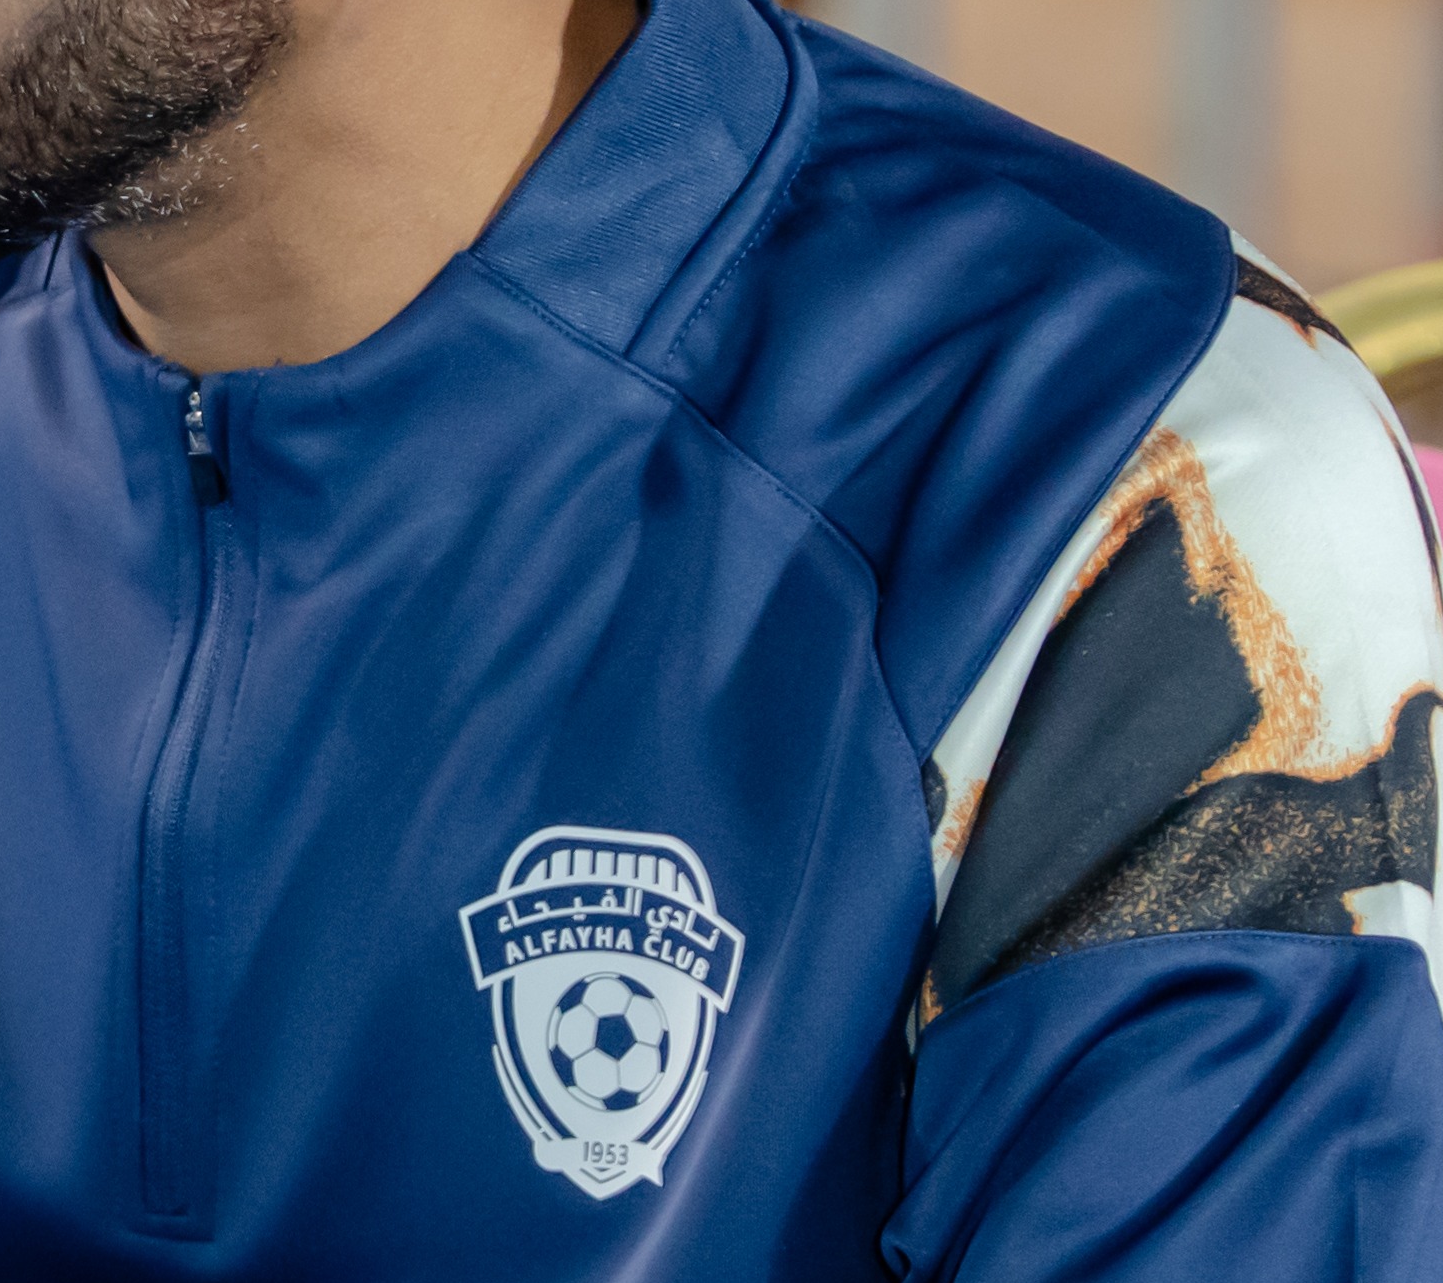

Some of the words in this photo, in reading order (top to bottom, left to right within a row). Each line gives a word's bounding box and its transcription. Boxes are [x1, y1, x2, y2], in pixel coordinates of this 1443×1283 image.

[505, 926, 634, 965] ALFAYHA
[643, 934, 710, 981] CLUB
[583, 1141, 629, 1165] 1953
